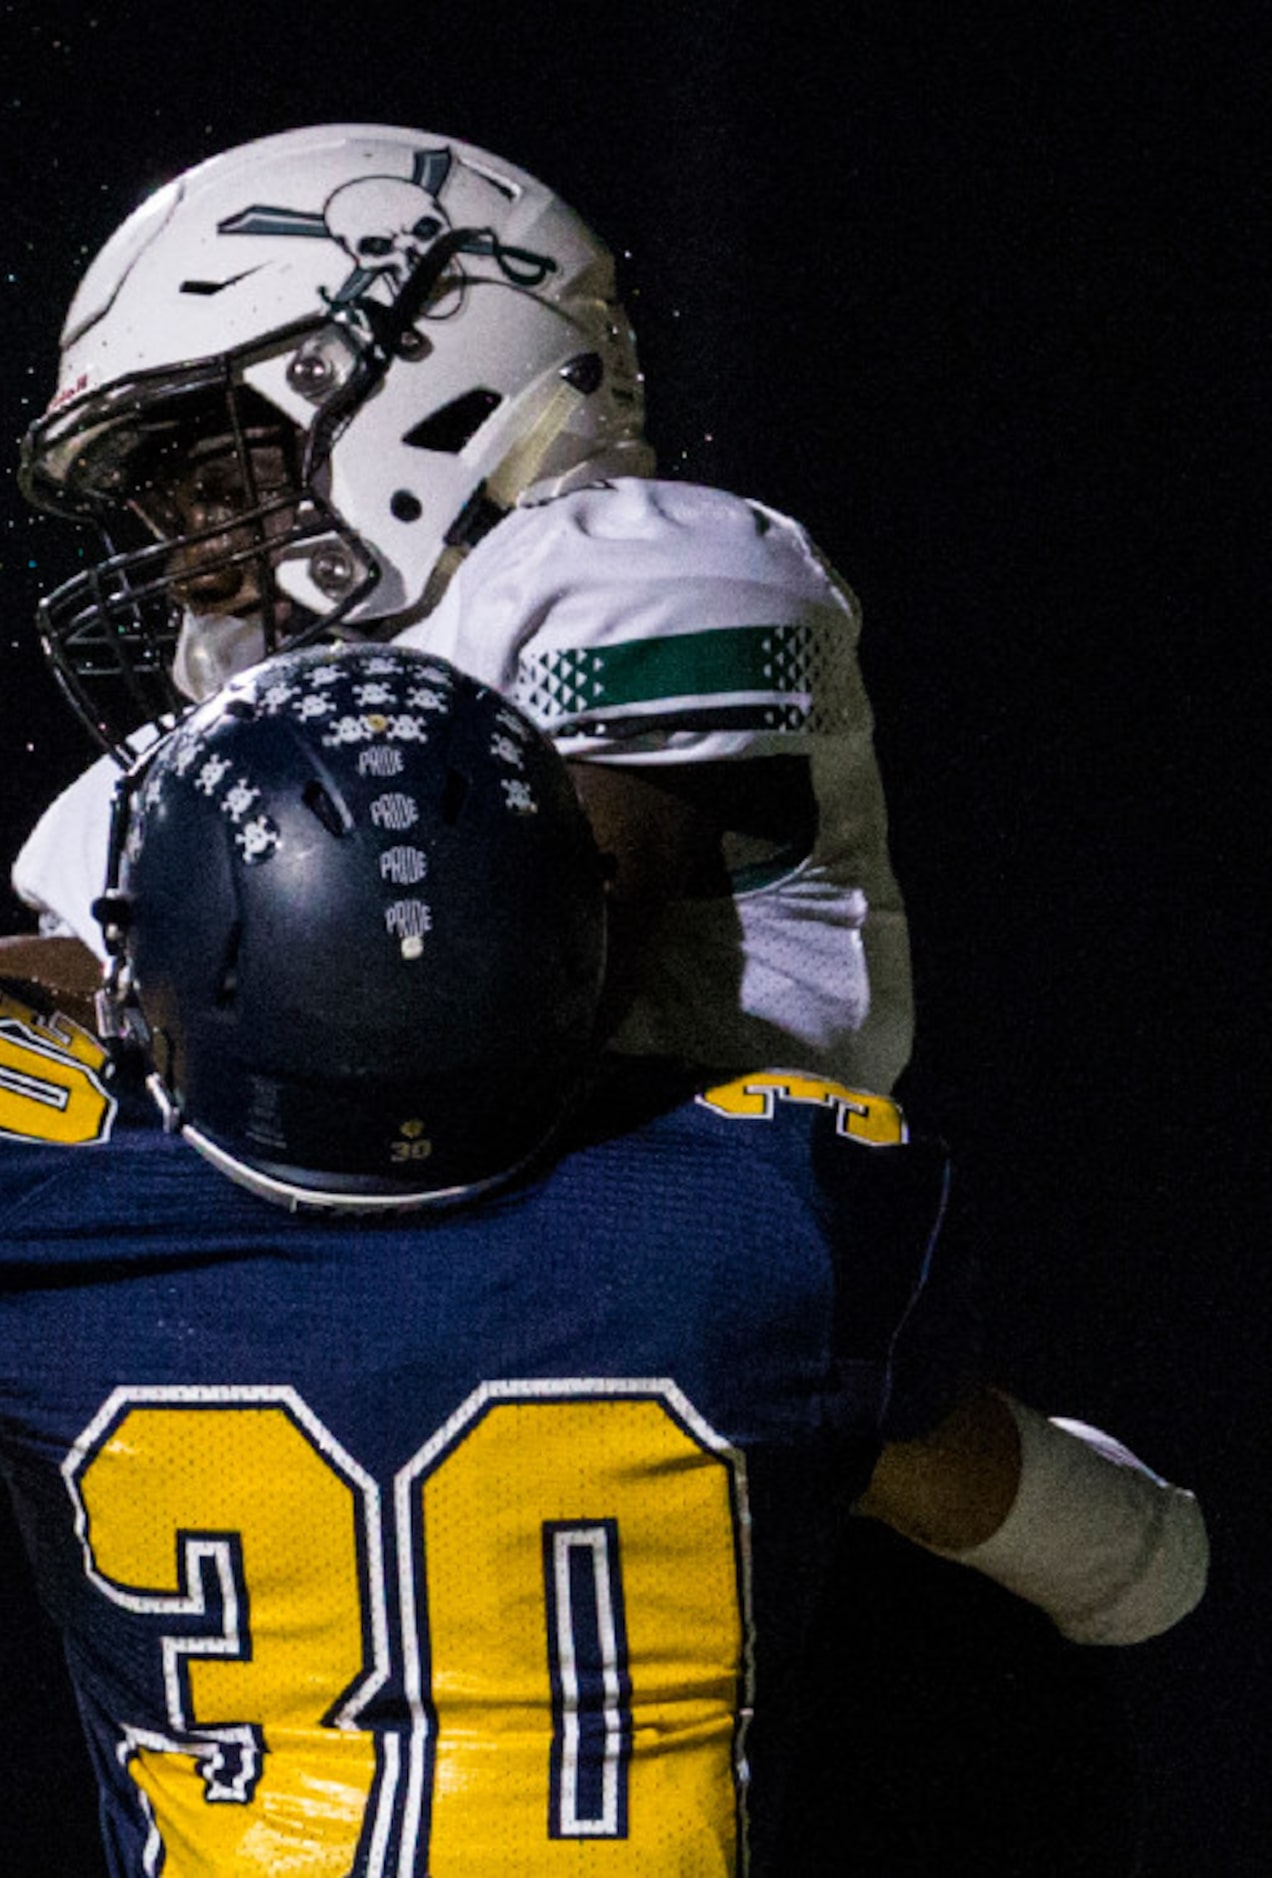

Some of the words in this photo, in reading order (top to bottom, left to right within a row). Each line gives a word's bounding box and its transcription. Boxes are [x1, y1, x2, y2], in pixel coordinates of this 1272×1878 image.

[358, 746, 405, 777] PRIDE
[369, 792, 419, 831] PRIDE
[380, 845, 428, 885] PRIDE
[385, 899, 433, 938] PRIDE
[390, 1139, 432, 1163] 30
[61, 1377, 756, 1878] 30
